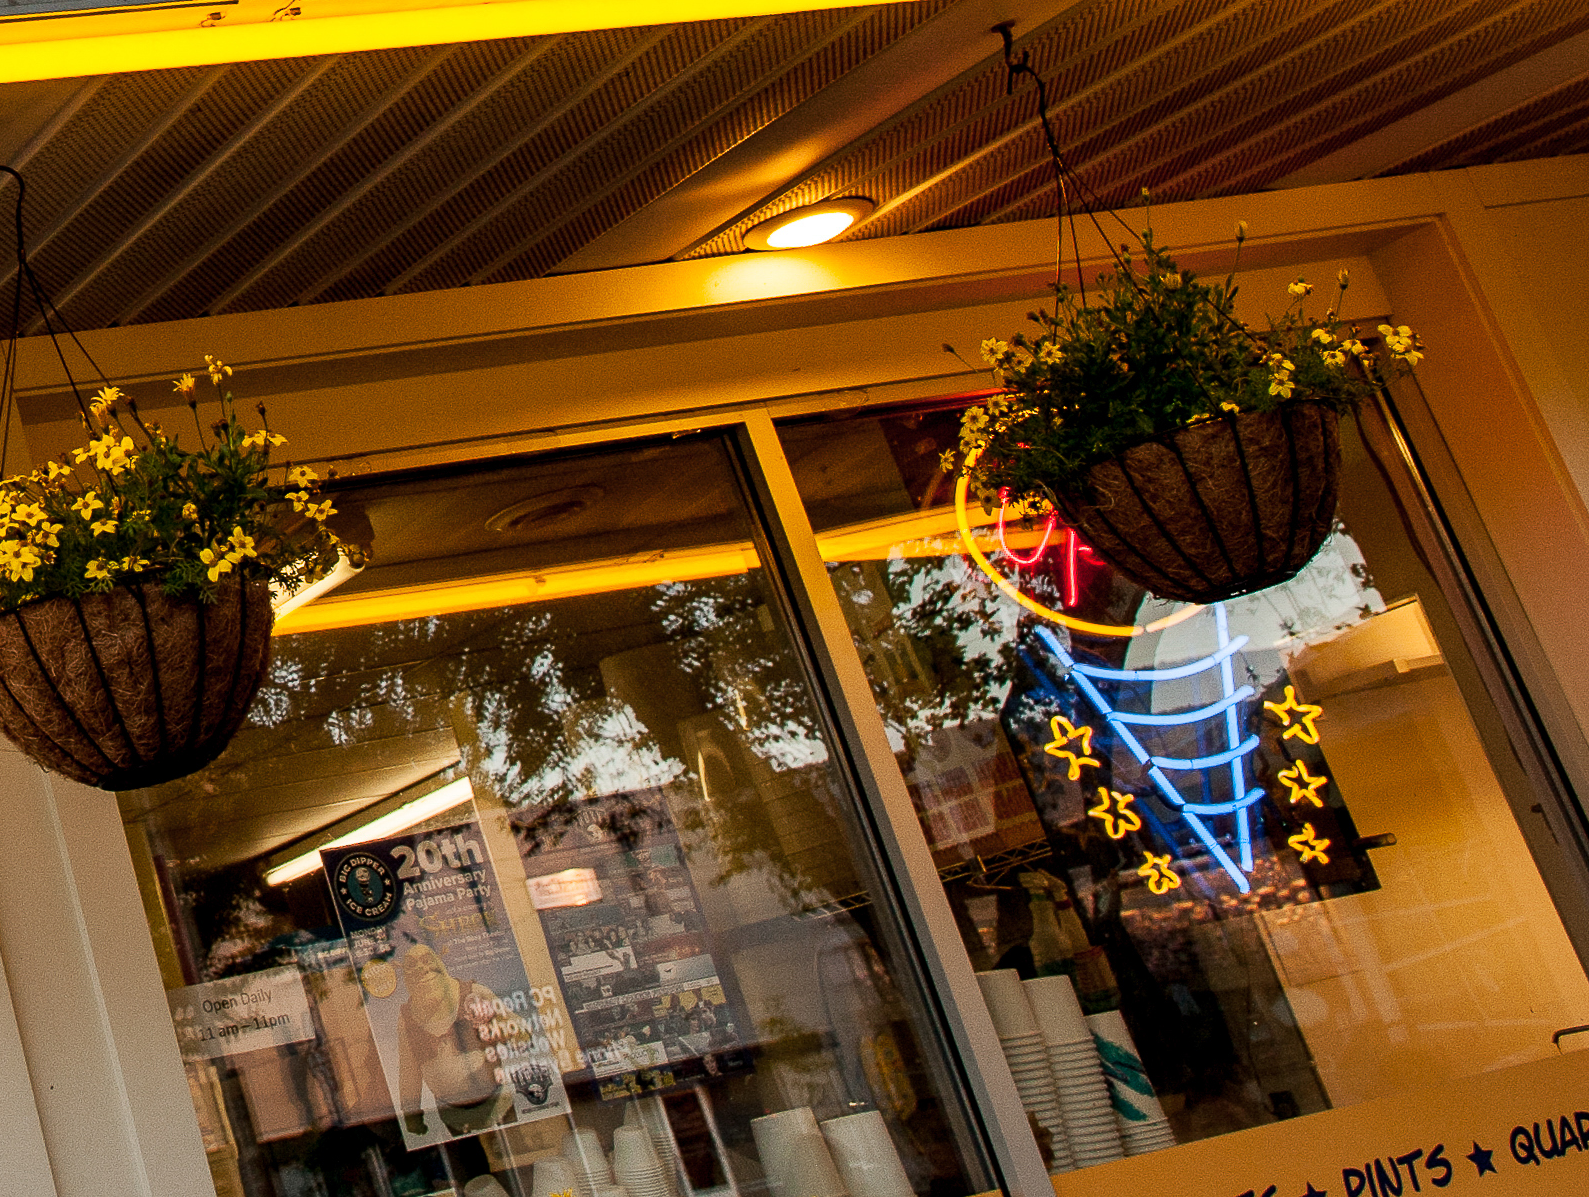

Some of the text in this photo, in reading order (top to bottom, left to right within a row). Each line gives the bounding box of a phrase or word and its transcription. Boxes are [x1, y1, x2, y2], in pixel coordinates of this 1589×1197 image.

[338, 856, 386, 883] BIG DIPPER
[390, 834, 484, 880] 20th
[403, 868, 487, 896] Anniversary
[345, 892, 393, 917] ICE CREAM
[406, 891, 455, 911] Pajama
[457, 883, 492, 901] Party
[202, 988, 272, 1014] Open Daily
[1342, 1143, 1454, 1197] PINTS
